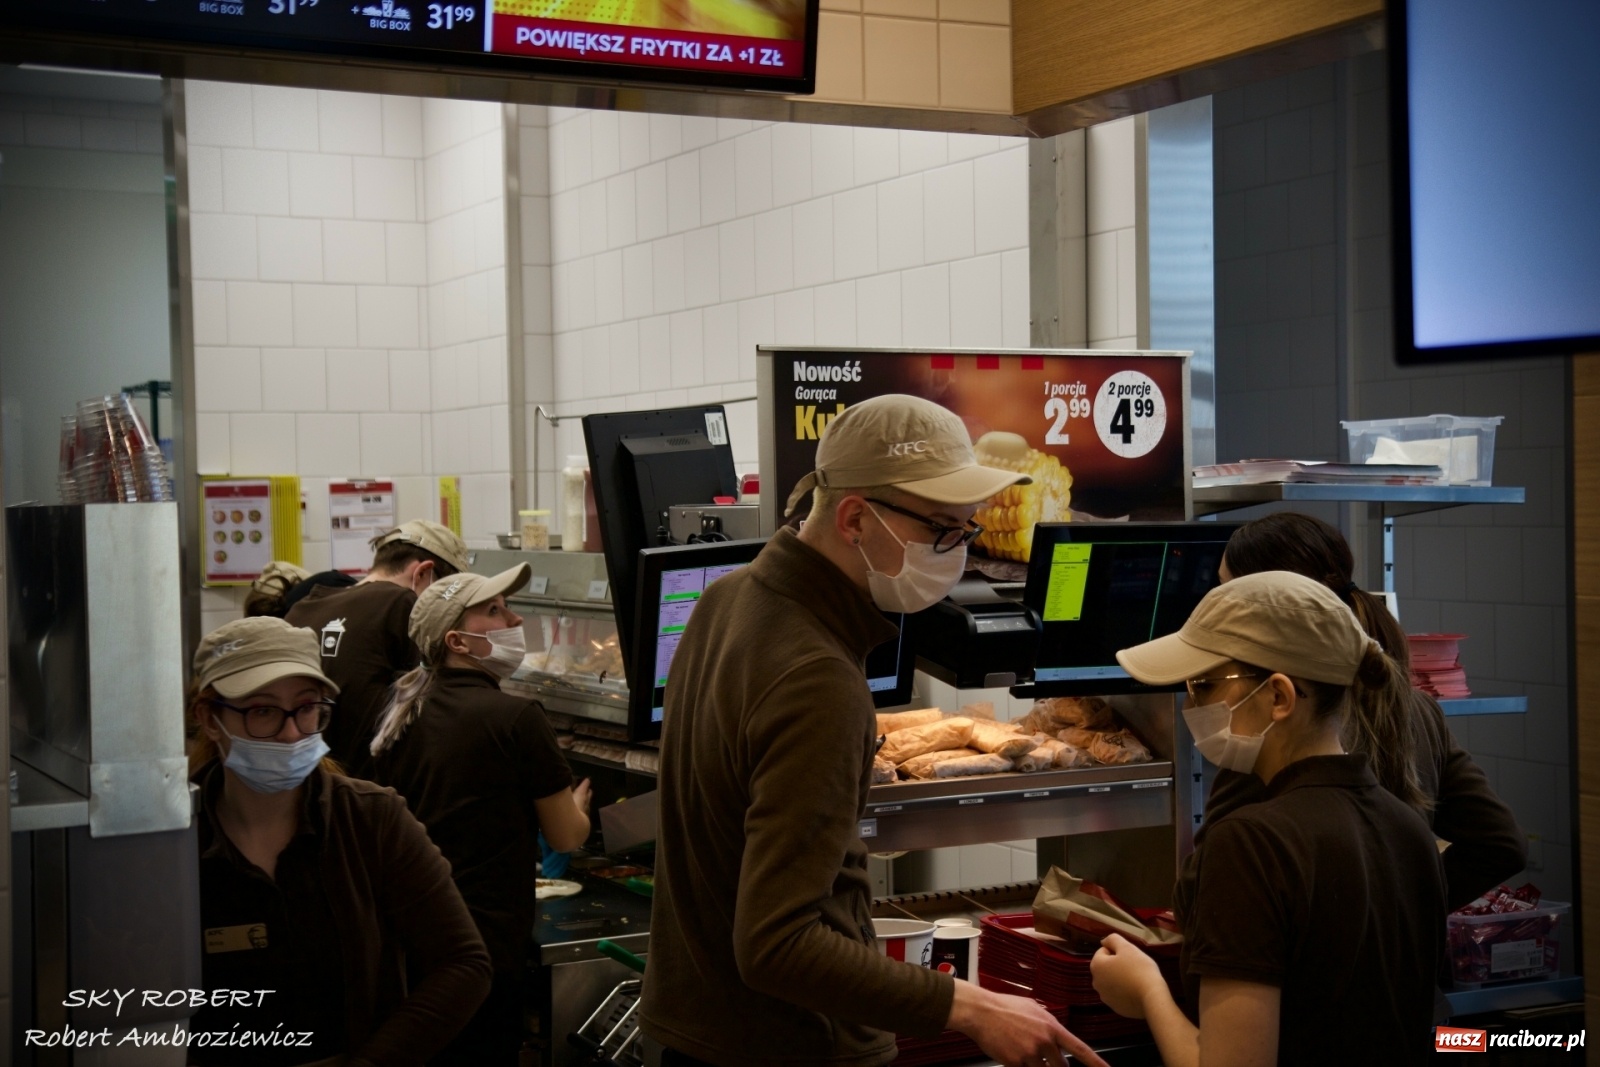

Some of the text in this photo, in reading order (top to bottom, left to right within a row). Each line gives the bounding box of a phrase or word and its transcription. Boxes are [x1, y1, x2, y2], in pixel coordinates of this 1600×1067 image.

[199, 2, 244, 15] BIG BOX
[369, 19, 411, 31] BIG BOX
[515, 27, 784, 67] POWIĘKSZ FRYTKI ZA +1 ZŁ
[793, 360, 862, 382] Nowość
[795, 385, 837, 403] Gorąca
[1044, 380, 1087, 398] 1 porcja
[1108, 382, 1151, 398] 2 porcje
[795, 403, 846, 440] Ku
[885, 440, 928, 457] KFC
[442, 581, 461, 600] KFC
